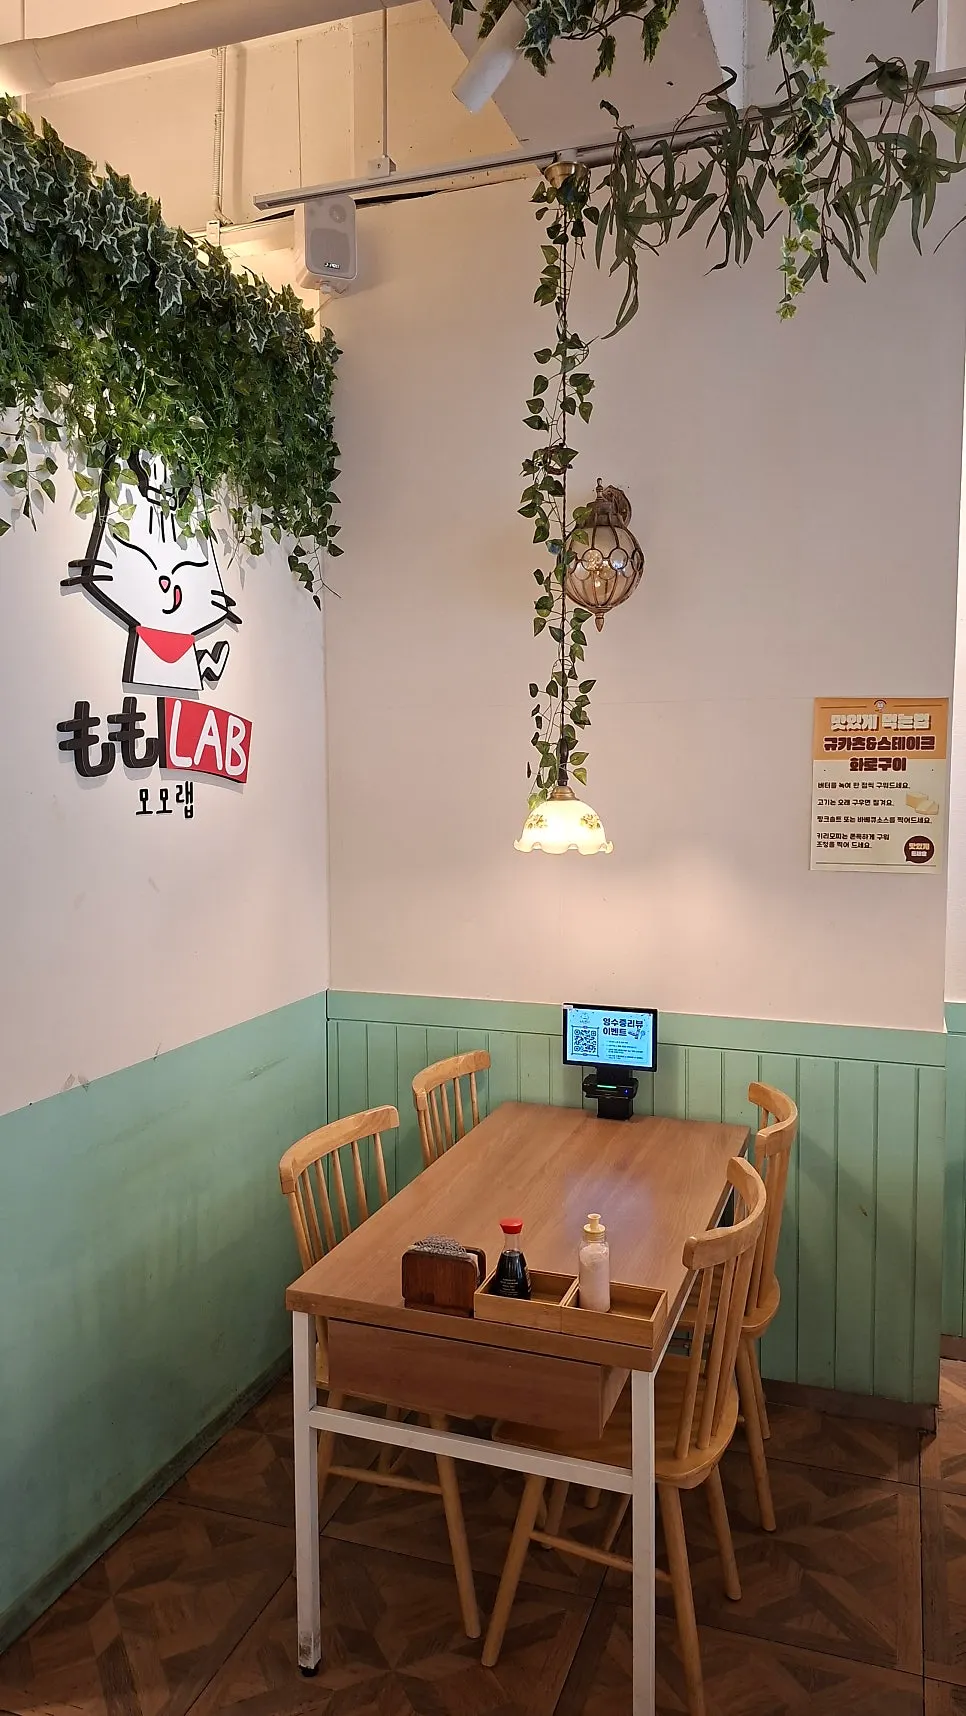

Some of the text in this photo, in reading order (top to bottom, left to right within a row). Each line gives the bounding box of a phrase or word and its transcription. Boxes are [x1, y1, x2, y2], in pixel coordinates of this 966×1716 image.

[831, 713, 931, 731] 맛있게 먹는법
[169, 698, 247, 777] LAB
[824, 736, 936, 751] 규카츠&스테이크
[849, 757, 907, 772] 화로구이
[603, 1018, 643, 1028] 영수증리뷰
[603, 1028, 627, 1036] 이벤트
